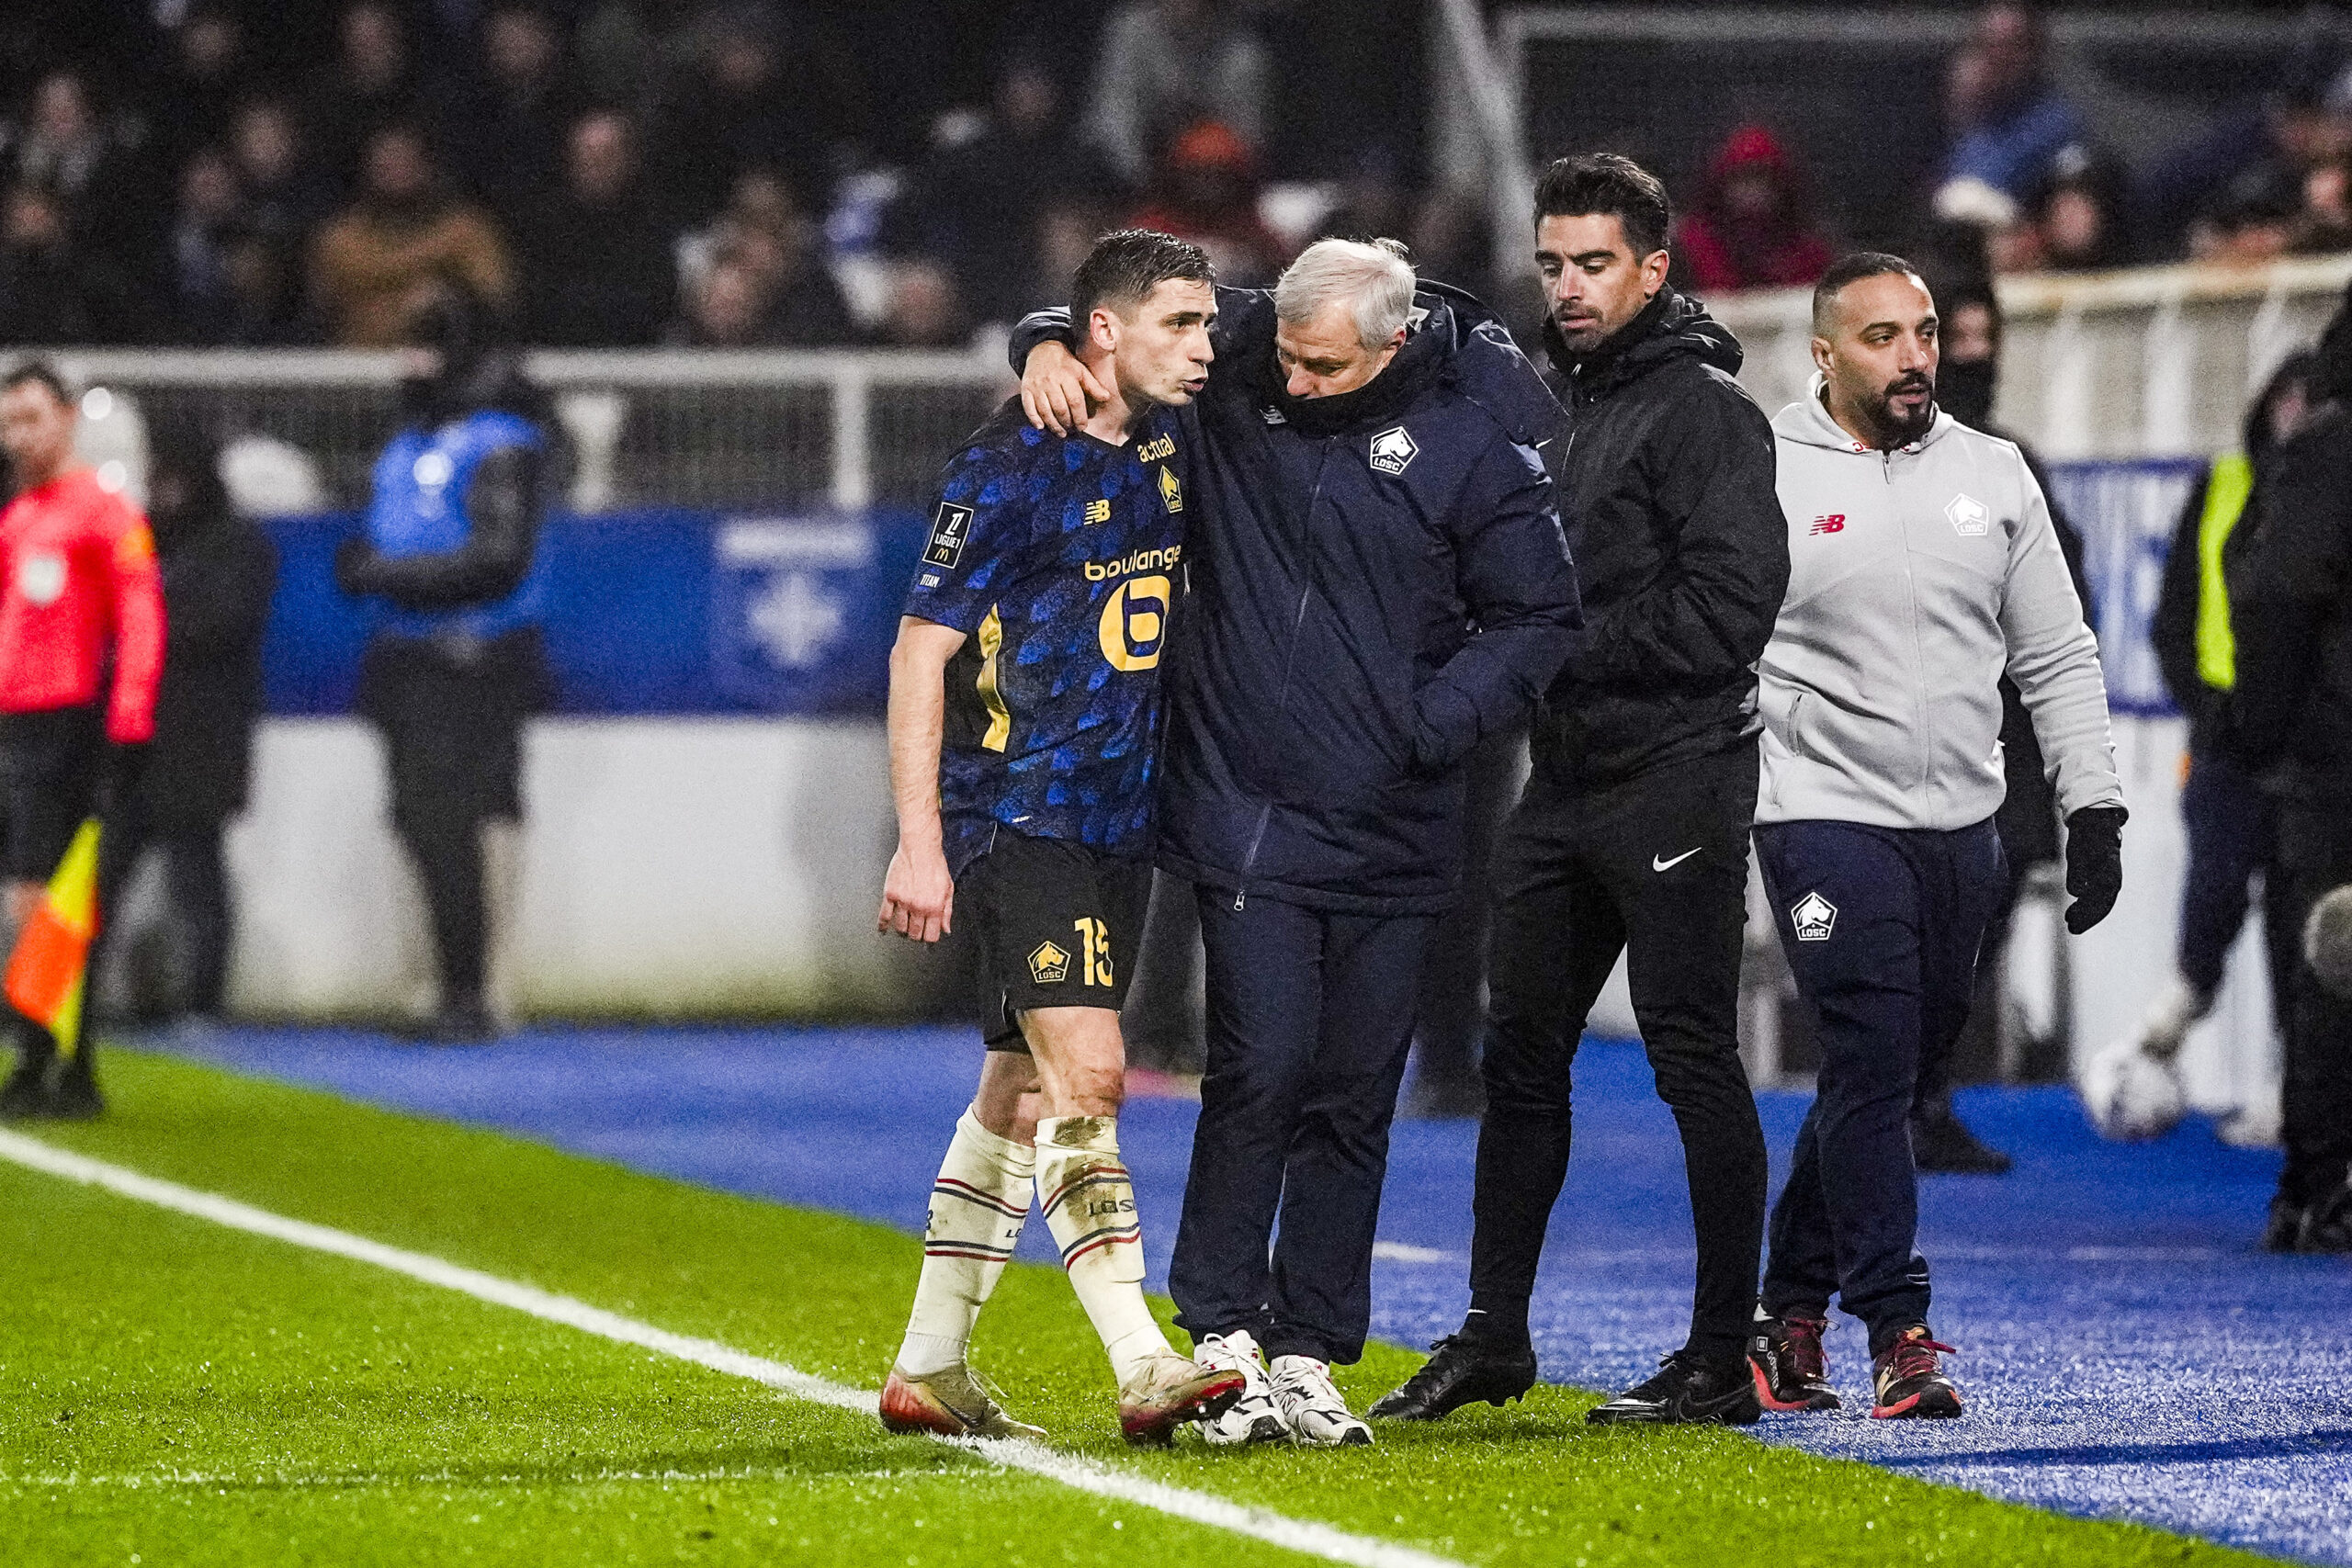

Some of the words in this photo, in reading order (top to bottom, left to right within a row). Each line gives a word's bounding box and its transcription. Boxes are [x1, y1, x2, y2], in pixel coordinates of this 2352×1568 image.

[1136, 432, 1176, 463] actual
[1374, 457, 1400, 471] LOSC
[1801, 928, 1826, 938] LOSC
[1038, 971, 1061, 980] LOSC
[1088, 1199, 1138, 1217] LOS
